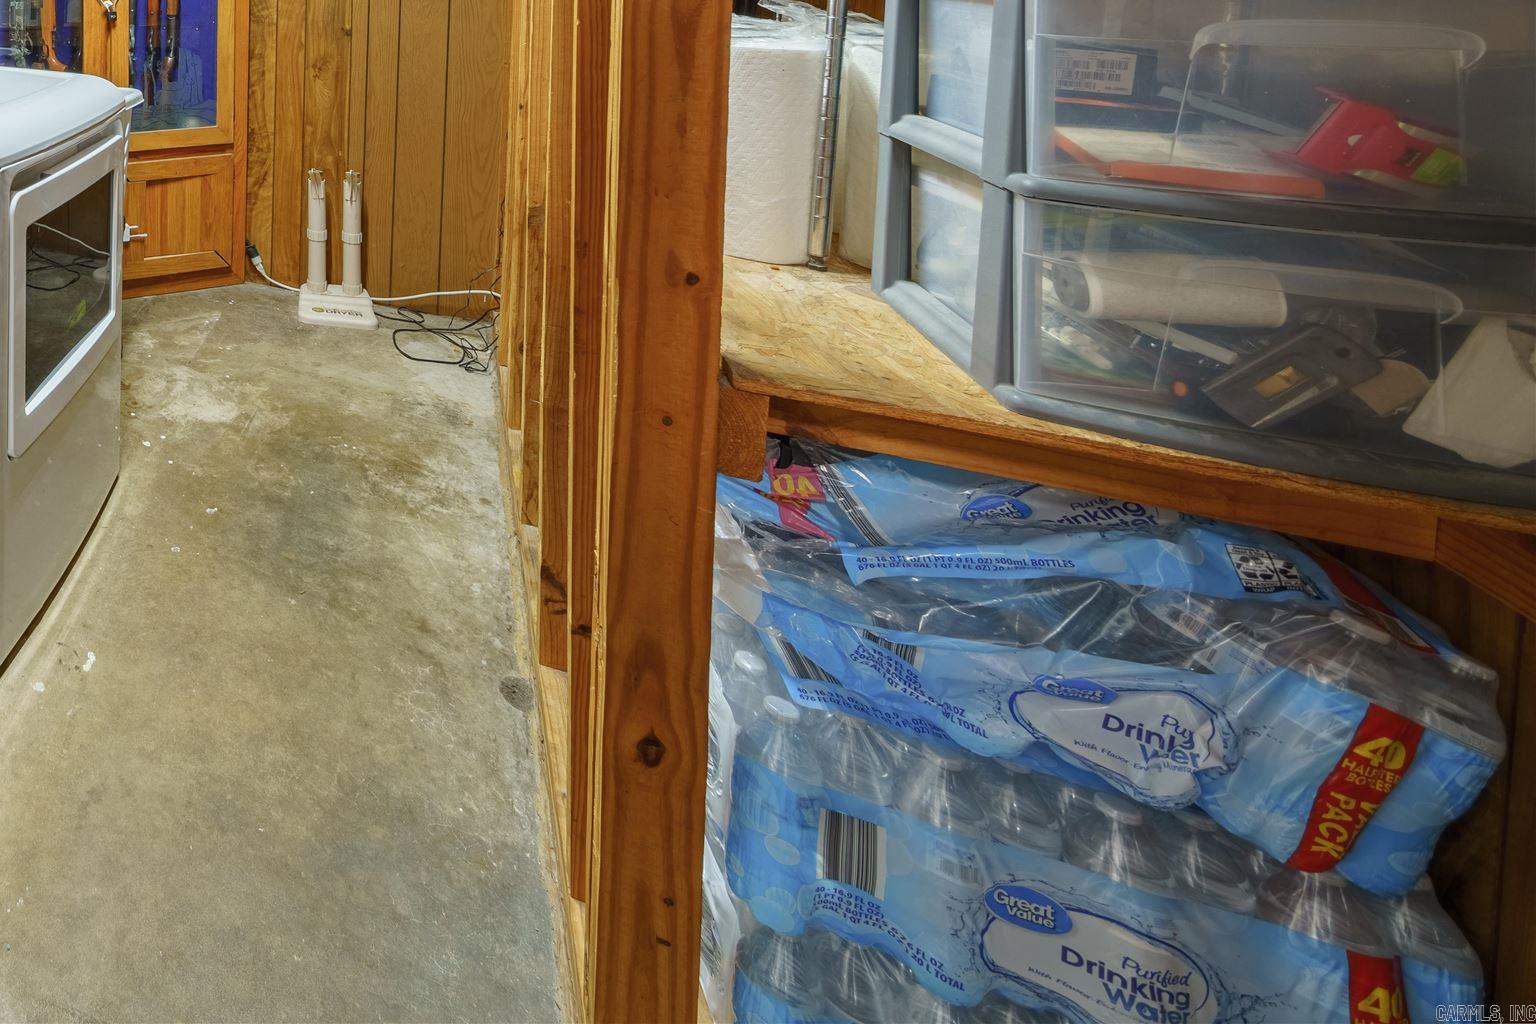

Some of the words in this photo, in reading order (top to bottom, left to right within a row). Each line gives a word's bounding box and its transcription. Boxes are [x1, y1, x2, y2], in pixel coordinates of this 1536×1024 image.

[1041, 501, 1147, 527] rinking
[1031, 559, 1075, 568] BOTTLES
[956, 717, 989, 740] TOTAL
[1310, 791, 1357, 861] PACK
[824, 893, 836, 902] PT
[837, 896, 852, 907] 0.9
[854, 902, 865, 912] FL
[866, 908, 885, 919] OZ)
[833, 887, 853, 900] 16.9
[854, 894, 866, 905] FL
[867, 900, 881, 911] OZ
[993, 888, 1055, 921] Great
[1005, 903, 1055, 929] Value
[845, 907, 889, 928] BOTTLES
[915, 948, 928, 962] FL
[929, 957, 945, 972] OZ
[934, 968, 966, 992] TOTAL
[1060, 944, 1191, 1012] Drinking
[1121, 955, 1192, 991] Purified
[1101, 981, 1191, 1024] Water
